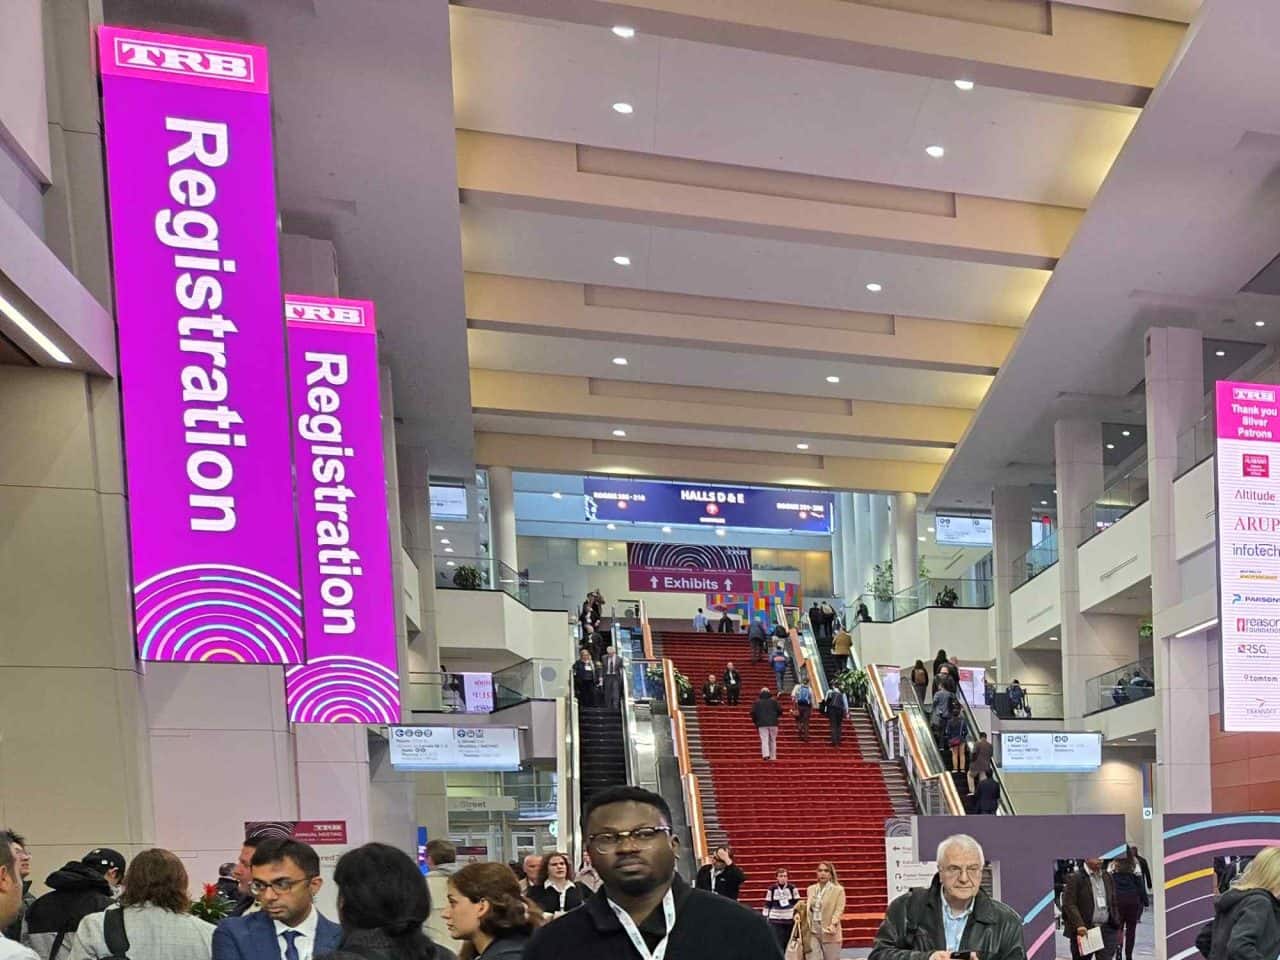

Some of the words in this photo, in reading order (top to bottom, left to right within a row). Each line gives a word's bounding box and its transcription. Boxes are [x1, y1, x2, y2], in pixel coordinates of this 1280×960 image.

[121, 43, 248, 79] TRB
[155, 116, 248, 533] Registration
[1232, 404, 1259, 416] Thank
[1261, 406, 1277, 417] you
[1242, 416, 1268, 427] Silver
[1238, 427, 1272, 439] Patrons
[298, 352, 363, 634] Registration
[681, 490, 715, 501] HALLS
[717, 492, 726, 502] D
[1234, 490, 1276, 502] Altitude
[1234, 517, 1280, 532] ARUP
[1233, 543, 1280, 558] infotech
[664, 576, 719, 591] Exhibits
